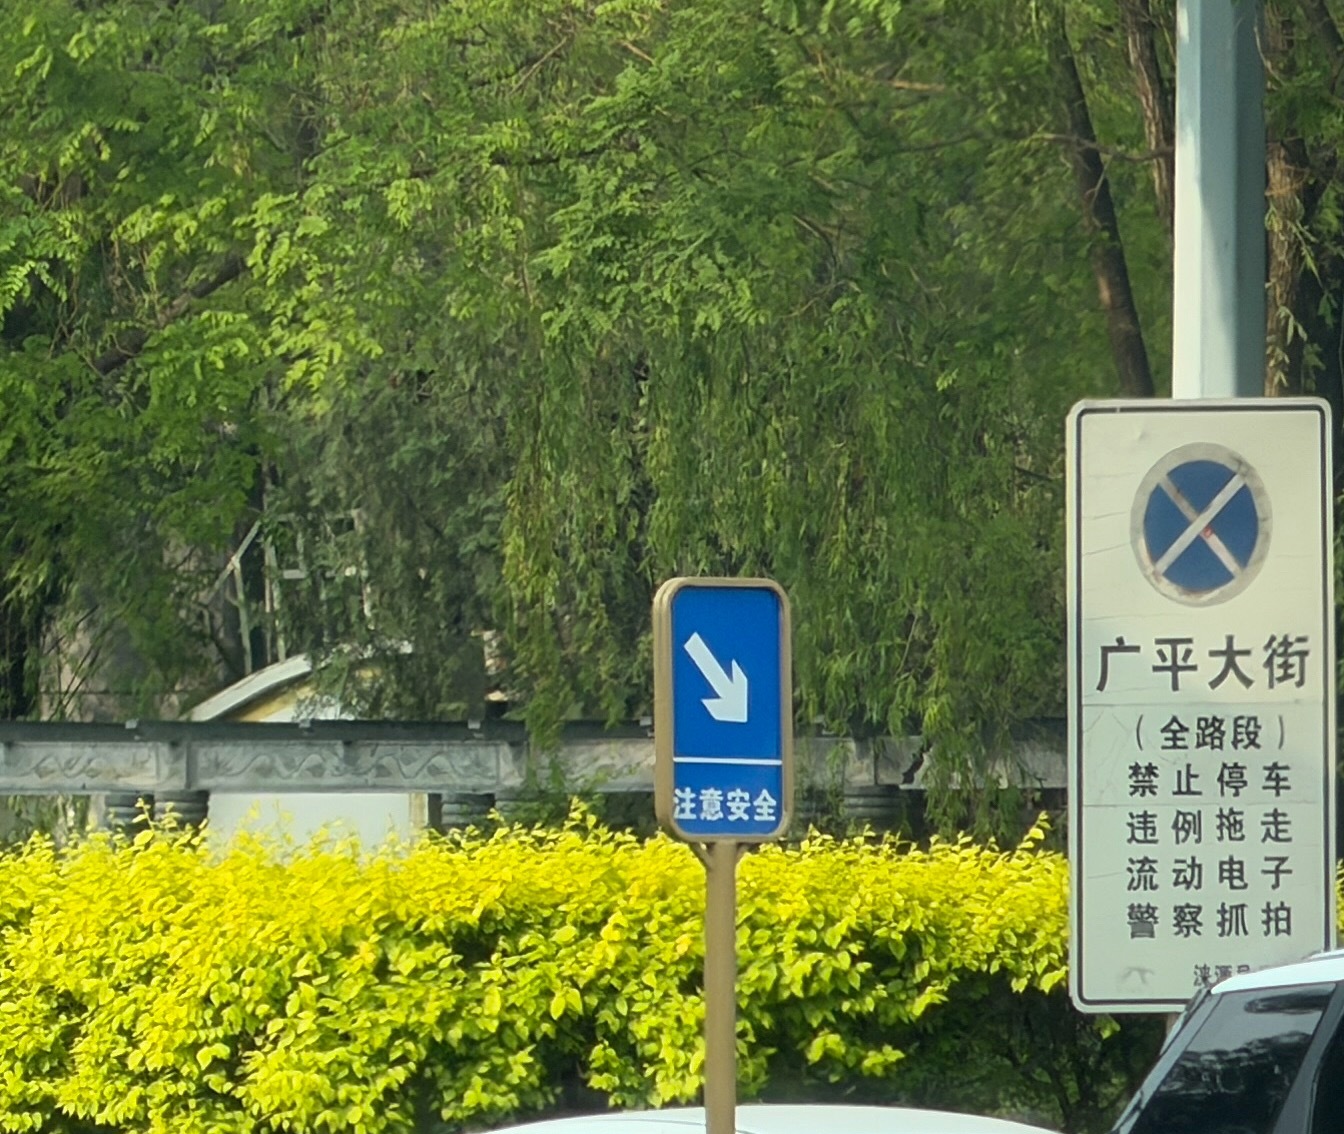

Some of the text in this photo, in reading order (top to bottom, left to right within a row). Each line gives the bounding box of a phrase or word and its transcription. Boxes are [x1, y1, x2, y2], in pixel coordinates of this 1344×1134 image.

[1097, 635, 1311, 692] 广平大街
[1128, 761, 1292, 798] 禁止停车
[673, 787, 776, 822] 注意安全
[1126, 807, 1293, 845] 违例拖走
[1126, 854, 1293, 892] 流动电子
[1126, 901, 1293, 940] 警察抓拍
